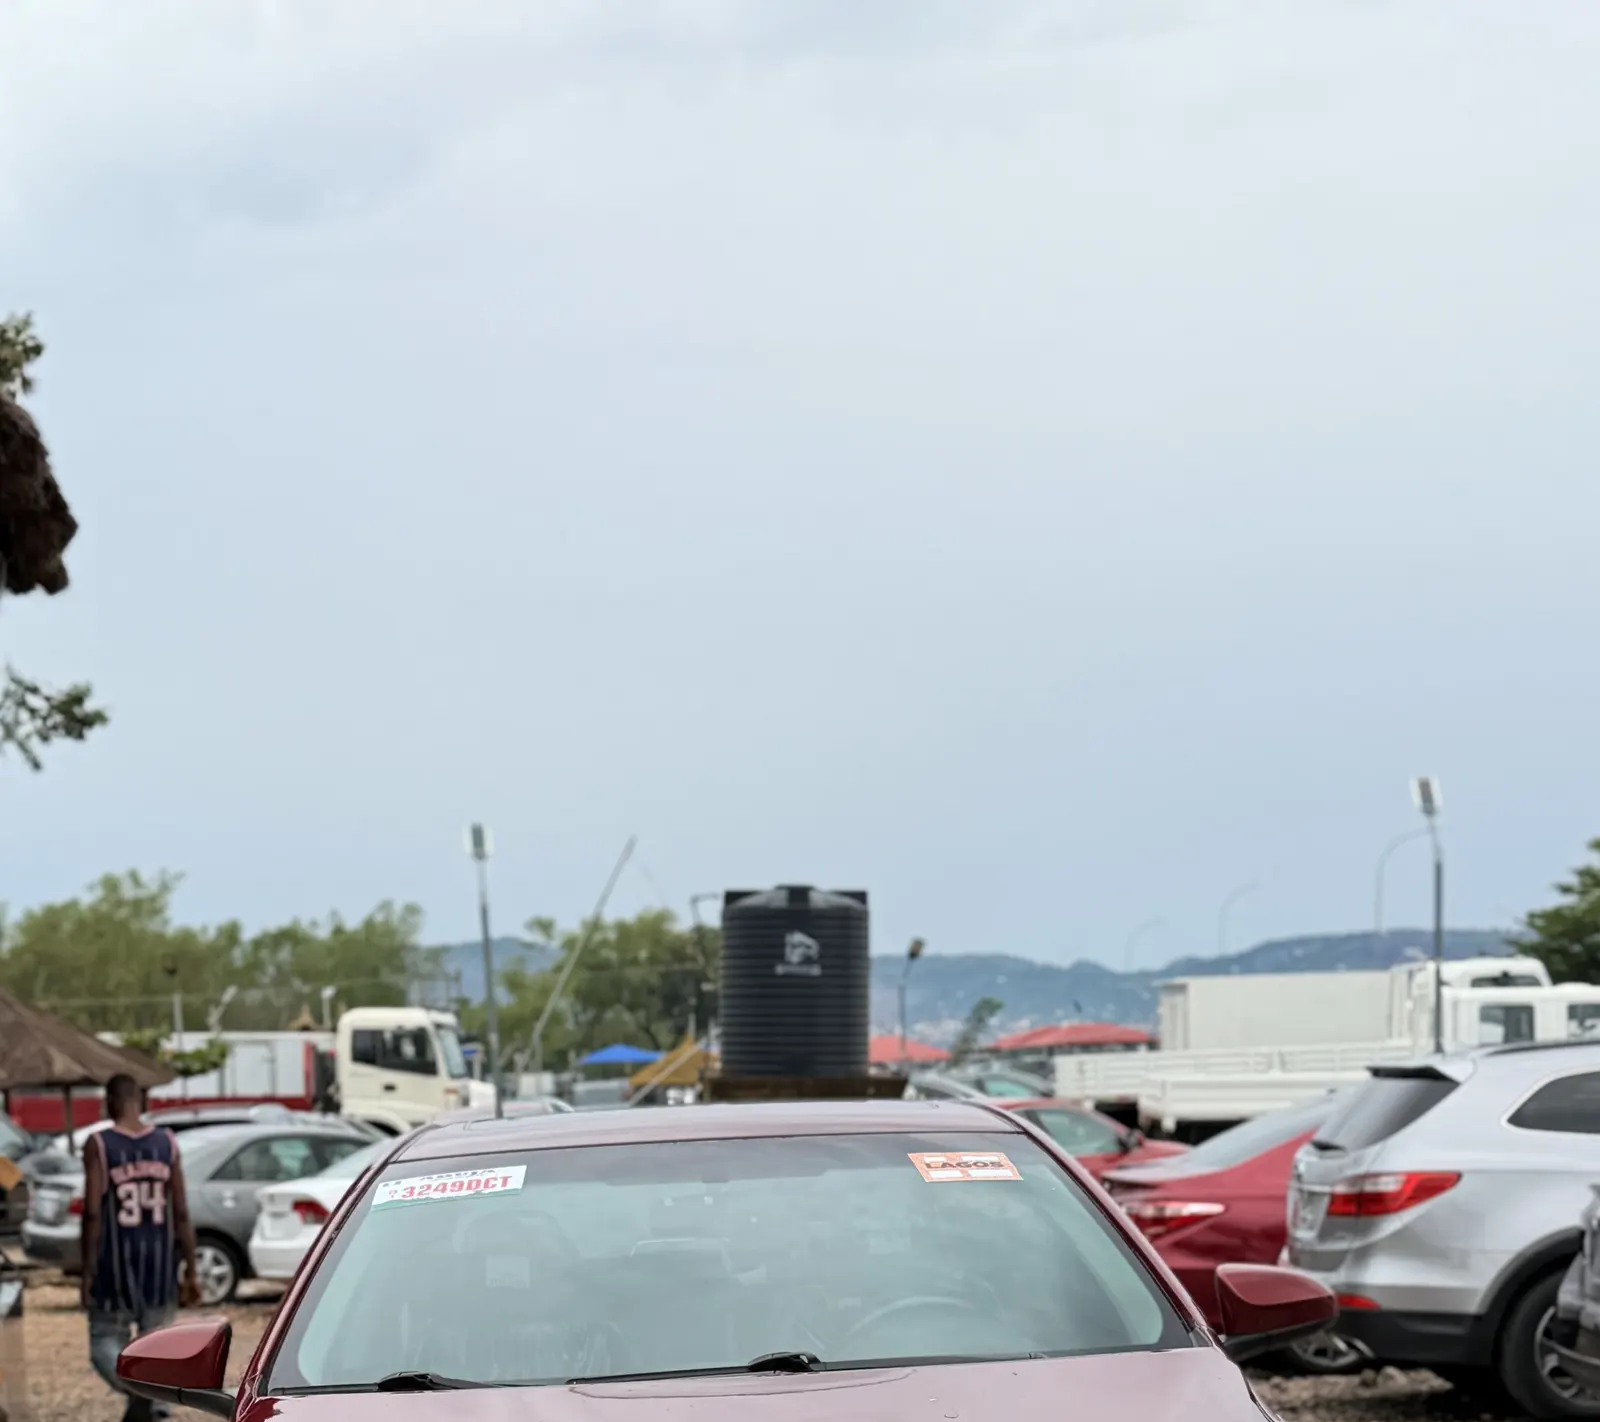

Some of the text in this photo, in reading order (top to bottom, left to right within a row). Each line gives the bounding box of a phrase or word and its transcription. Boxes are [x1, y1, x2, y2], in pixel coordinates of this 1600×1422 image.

[925, 1161, 1004, 1169] LAGOS
[401, 1176, 513, 1198] 3249DCT
[116, 1182, 166, 1227] 34
